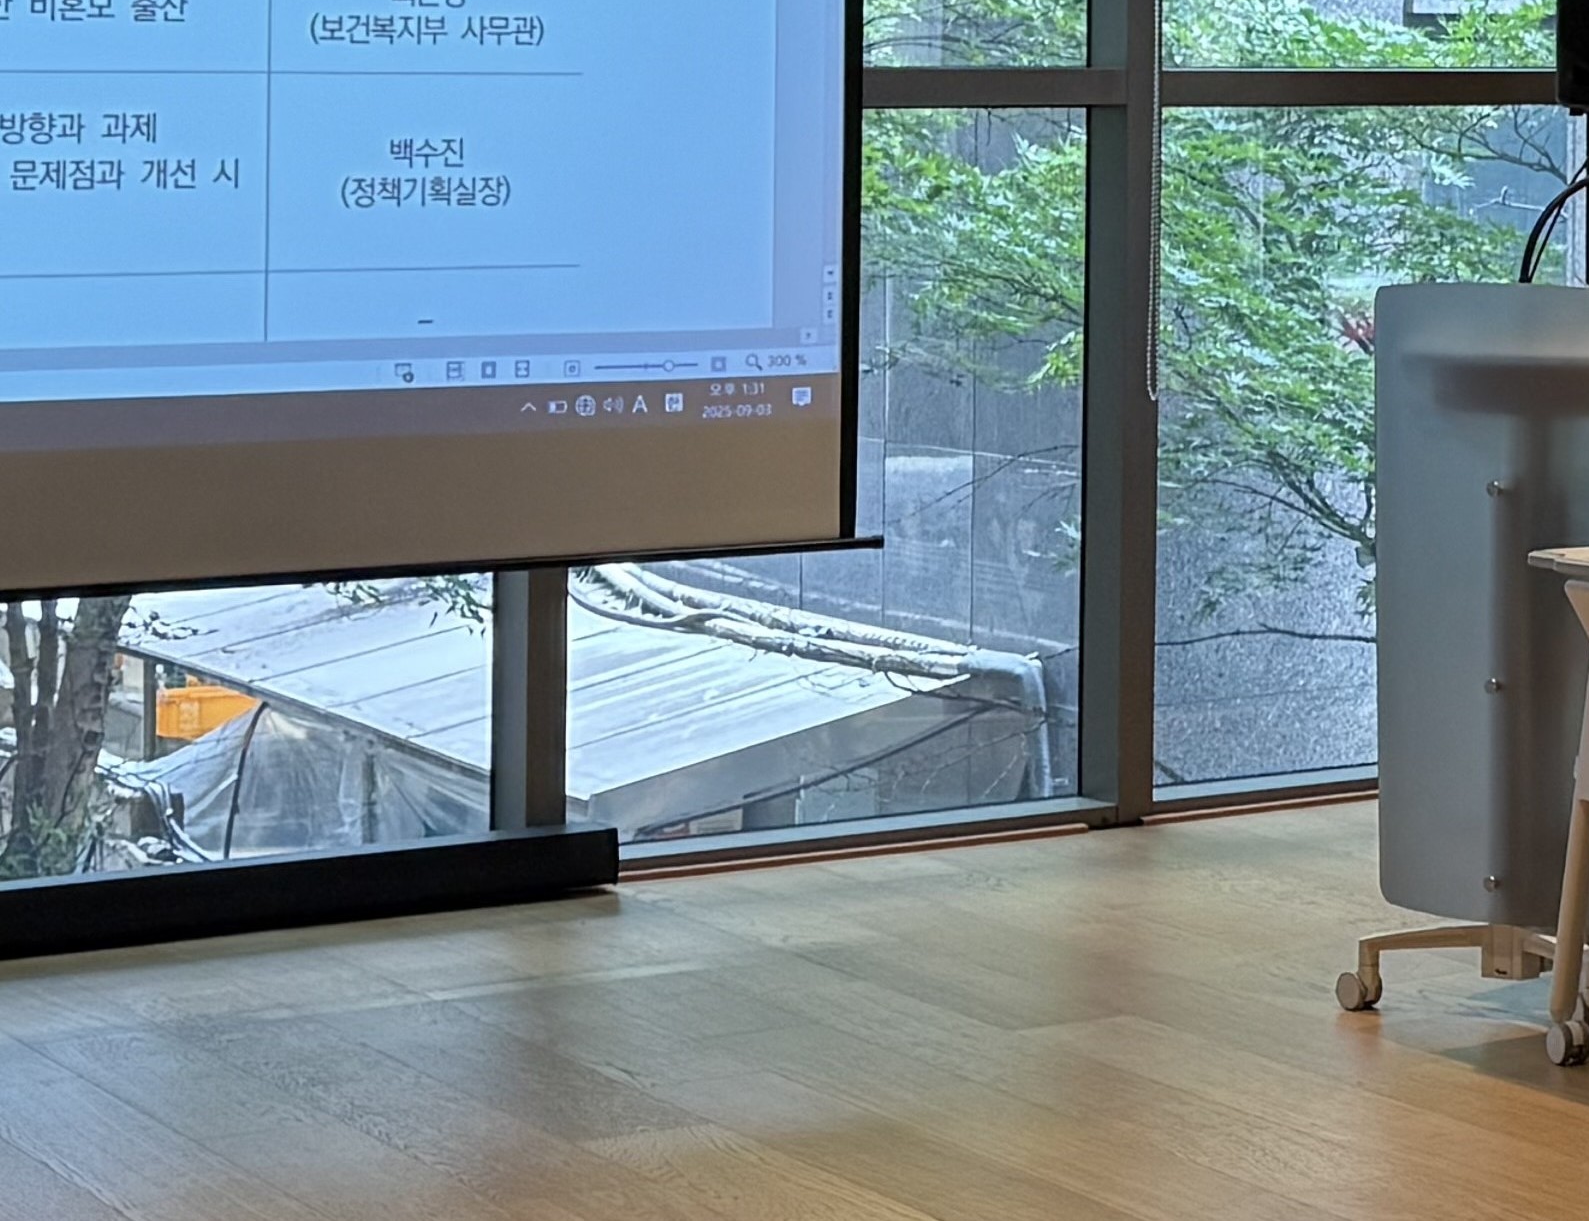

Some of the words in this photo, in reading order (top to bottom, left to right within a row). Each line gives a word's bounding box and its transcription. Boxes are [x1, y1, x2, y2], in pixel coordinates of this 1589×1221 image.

[310, 12, 449, 45] (보건복지부
[460, 14, 545, 47] 사무관)
[0, 111, 86, 145] 방향과
[101, 111, 158, 144] 과제
[390, 137, 465, 168] 백수진
[10, 158, 125, 191] 문제점과
[141, 158, 197, 190] 개선
[212, 157, 240, 190] 시
[340, 175, 512, 209] (정책기획실장)
[702, 402, 773, 419] 2025-09-03
